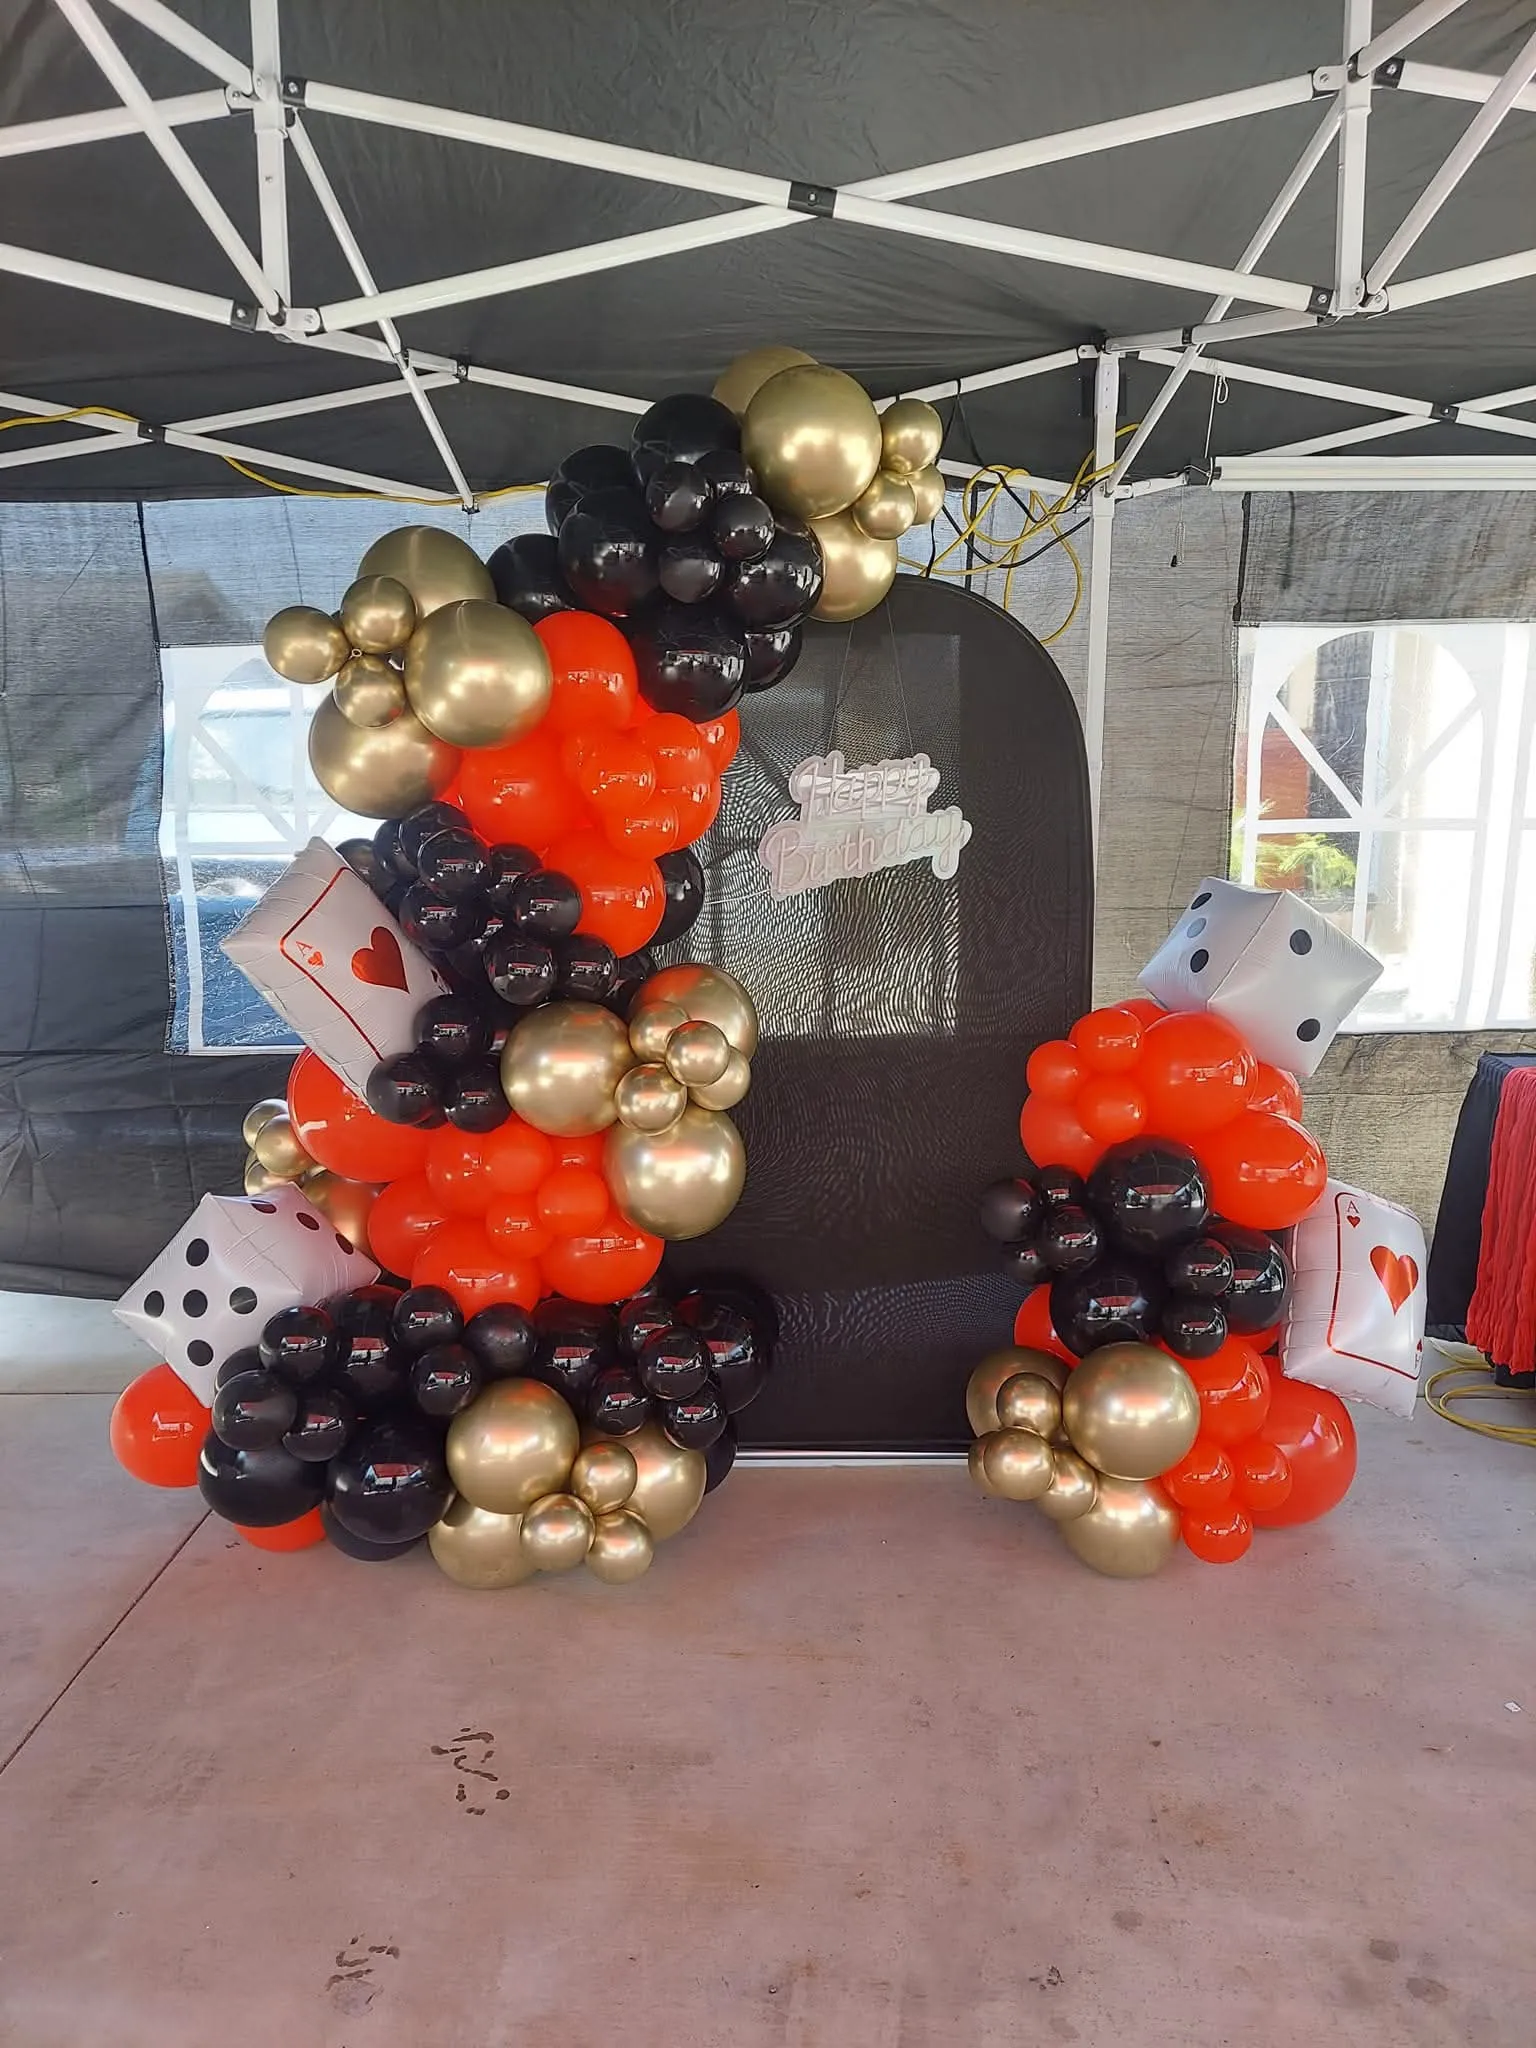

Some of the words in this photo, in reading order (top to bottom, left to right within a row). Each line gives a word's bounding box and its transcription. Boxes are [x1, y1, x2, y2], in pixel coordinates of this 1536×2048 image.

[793, 757, 937, 828] Happy
[764, 812, 968, 893] Birthday
[296, 941, 313, 958] A
[1347, 1201, 1360, 1213] A
